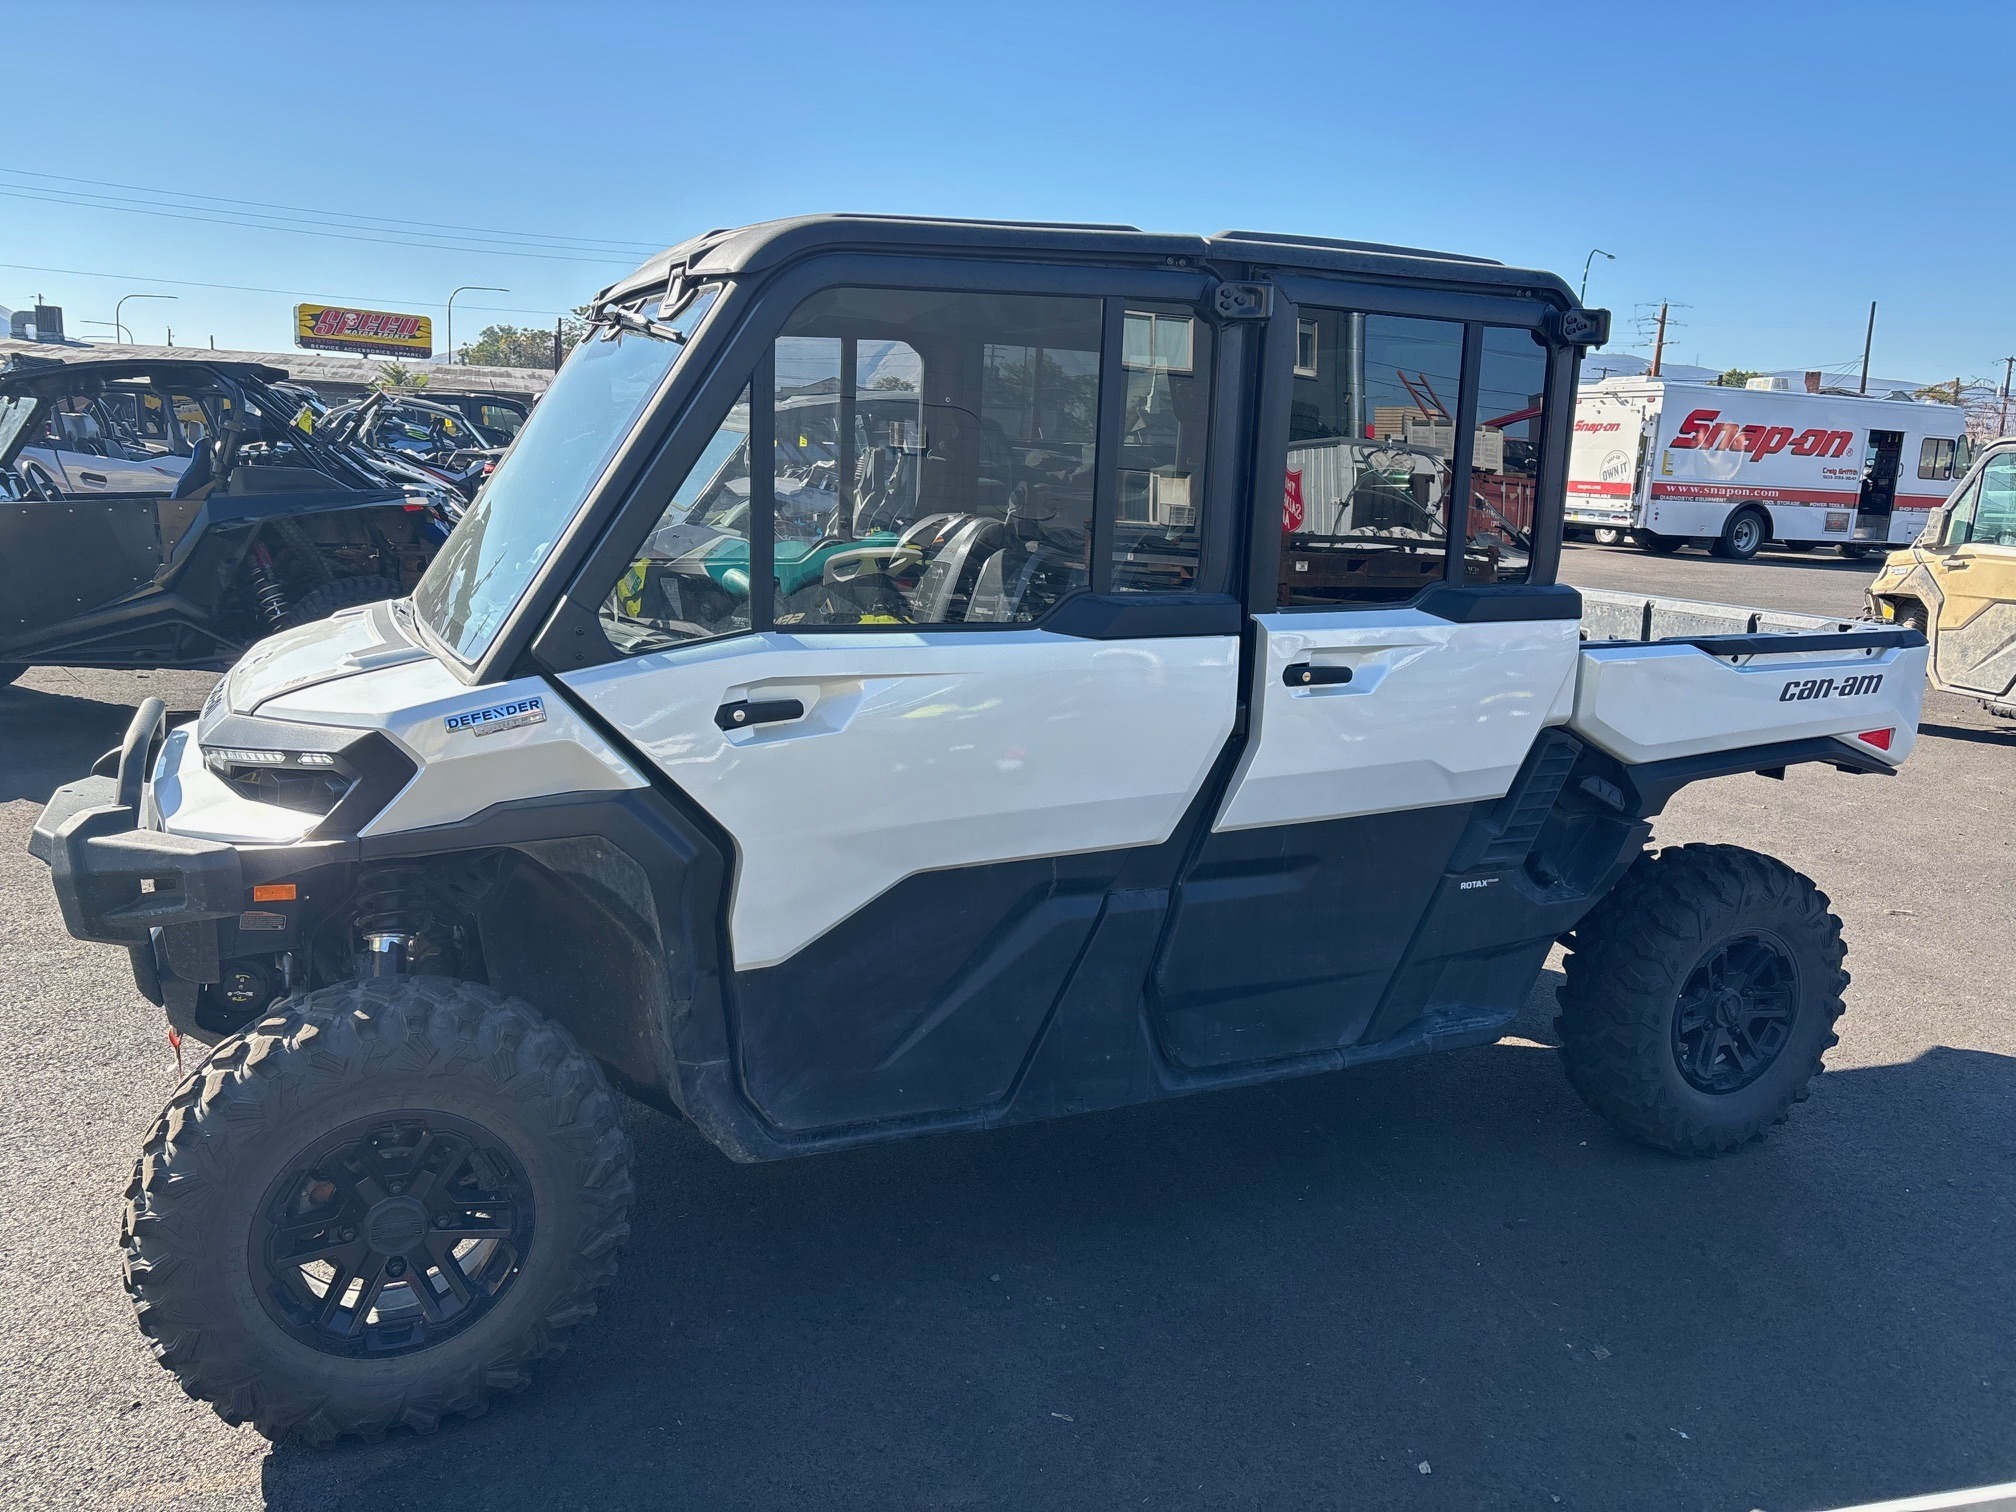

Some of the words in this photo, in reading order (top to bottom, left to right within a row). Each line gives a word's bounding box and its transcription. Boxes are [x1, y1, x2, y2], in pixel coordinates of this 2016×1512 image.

[313, 309, 420, 336] SPEED
[303, 337, 340, 345] CUSTOM
[378, 332, 410, 340] SPORTS
[343, 347, 391, 355] ACCESSORIES
[1574, 419, 1621, 434] Snap-on
[1669, 408, 1854, 463] Snap-on
[1602, 465, 1619, 481] OWN
[1620, 461, 1628, 474] IT
[1666, 485, 1779, 498] www.snapon.com
[1779, 674, 1884, 702] can-am
[447, 699, 540, 728] DEFENDER
[1460, 879, 1488, 890] ROTAX
